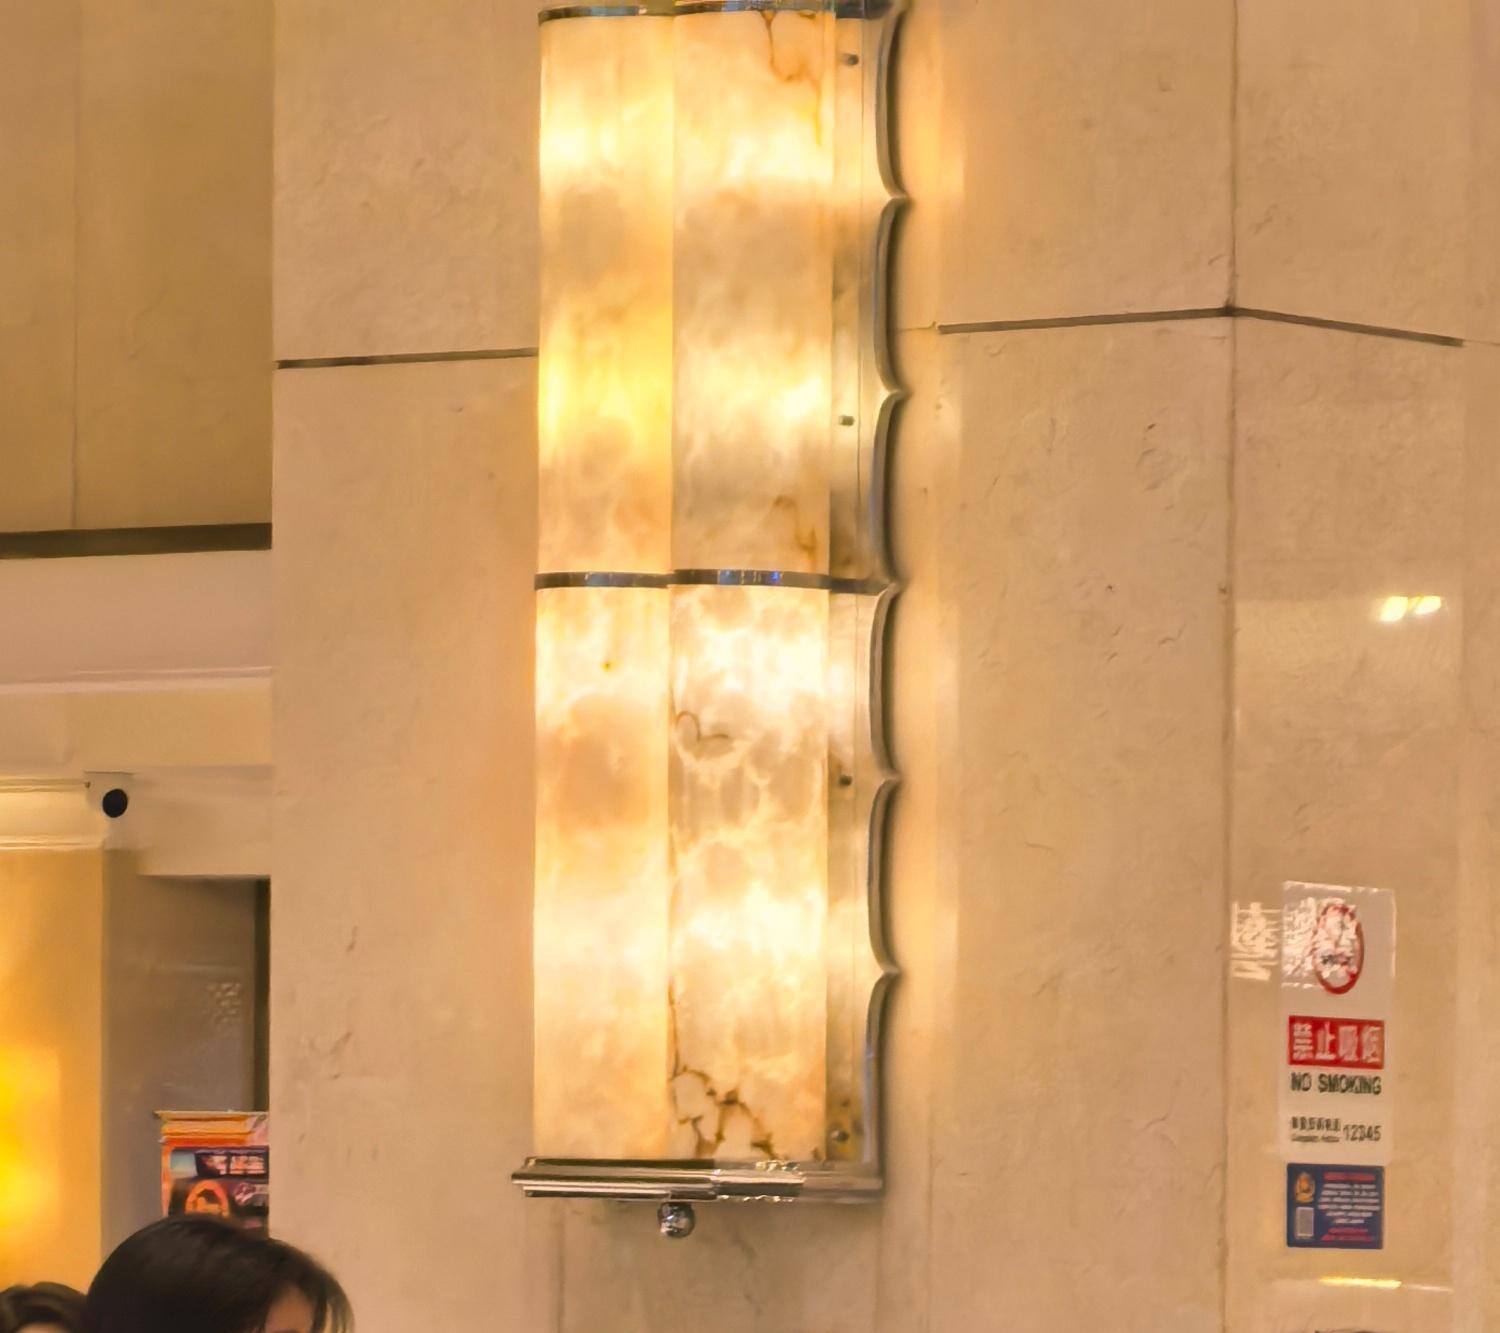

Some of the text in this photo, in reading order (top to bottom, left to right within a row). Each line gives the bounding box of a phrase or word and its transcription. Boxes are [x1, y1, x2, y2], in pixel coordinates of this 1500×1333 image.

[1291, 1072, 1382, 1095] NO SMOKING
[1343, 1124, 1382, 1142] 12345
